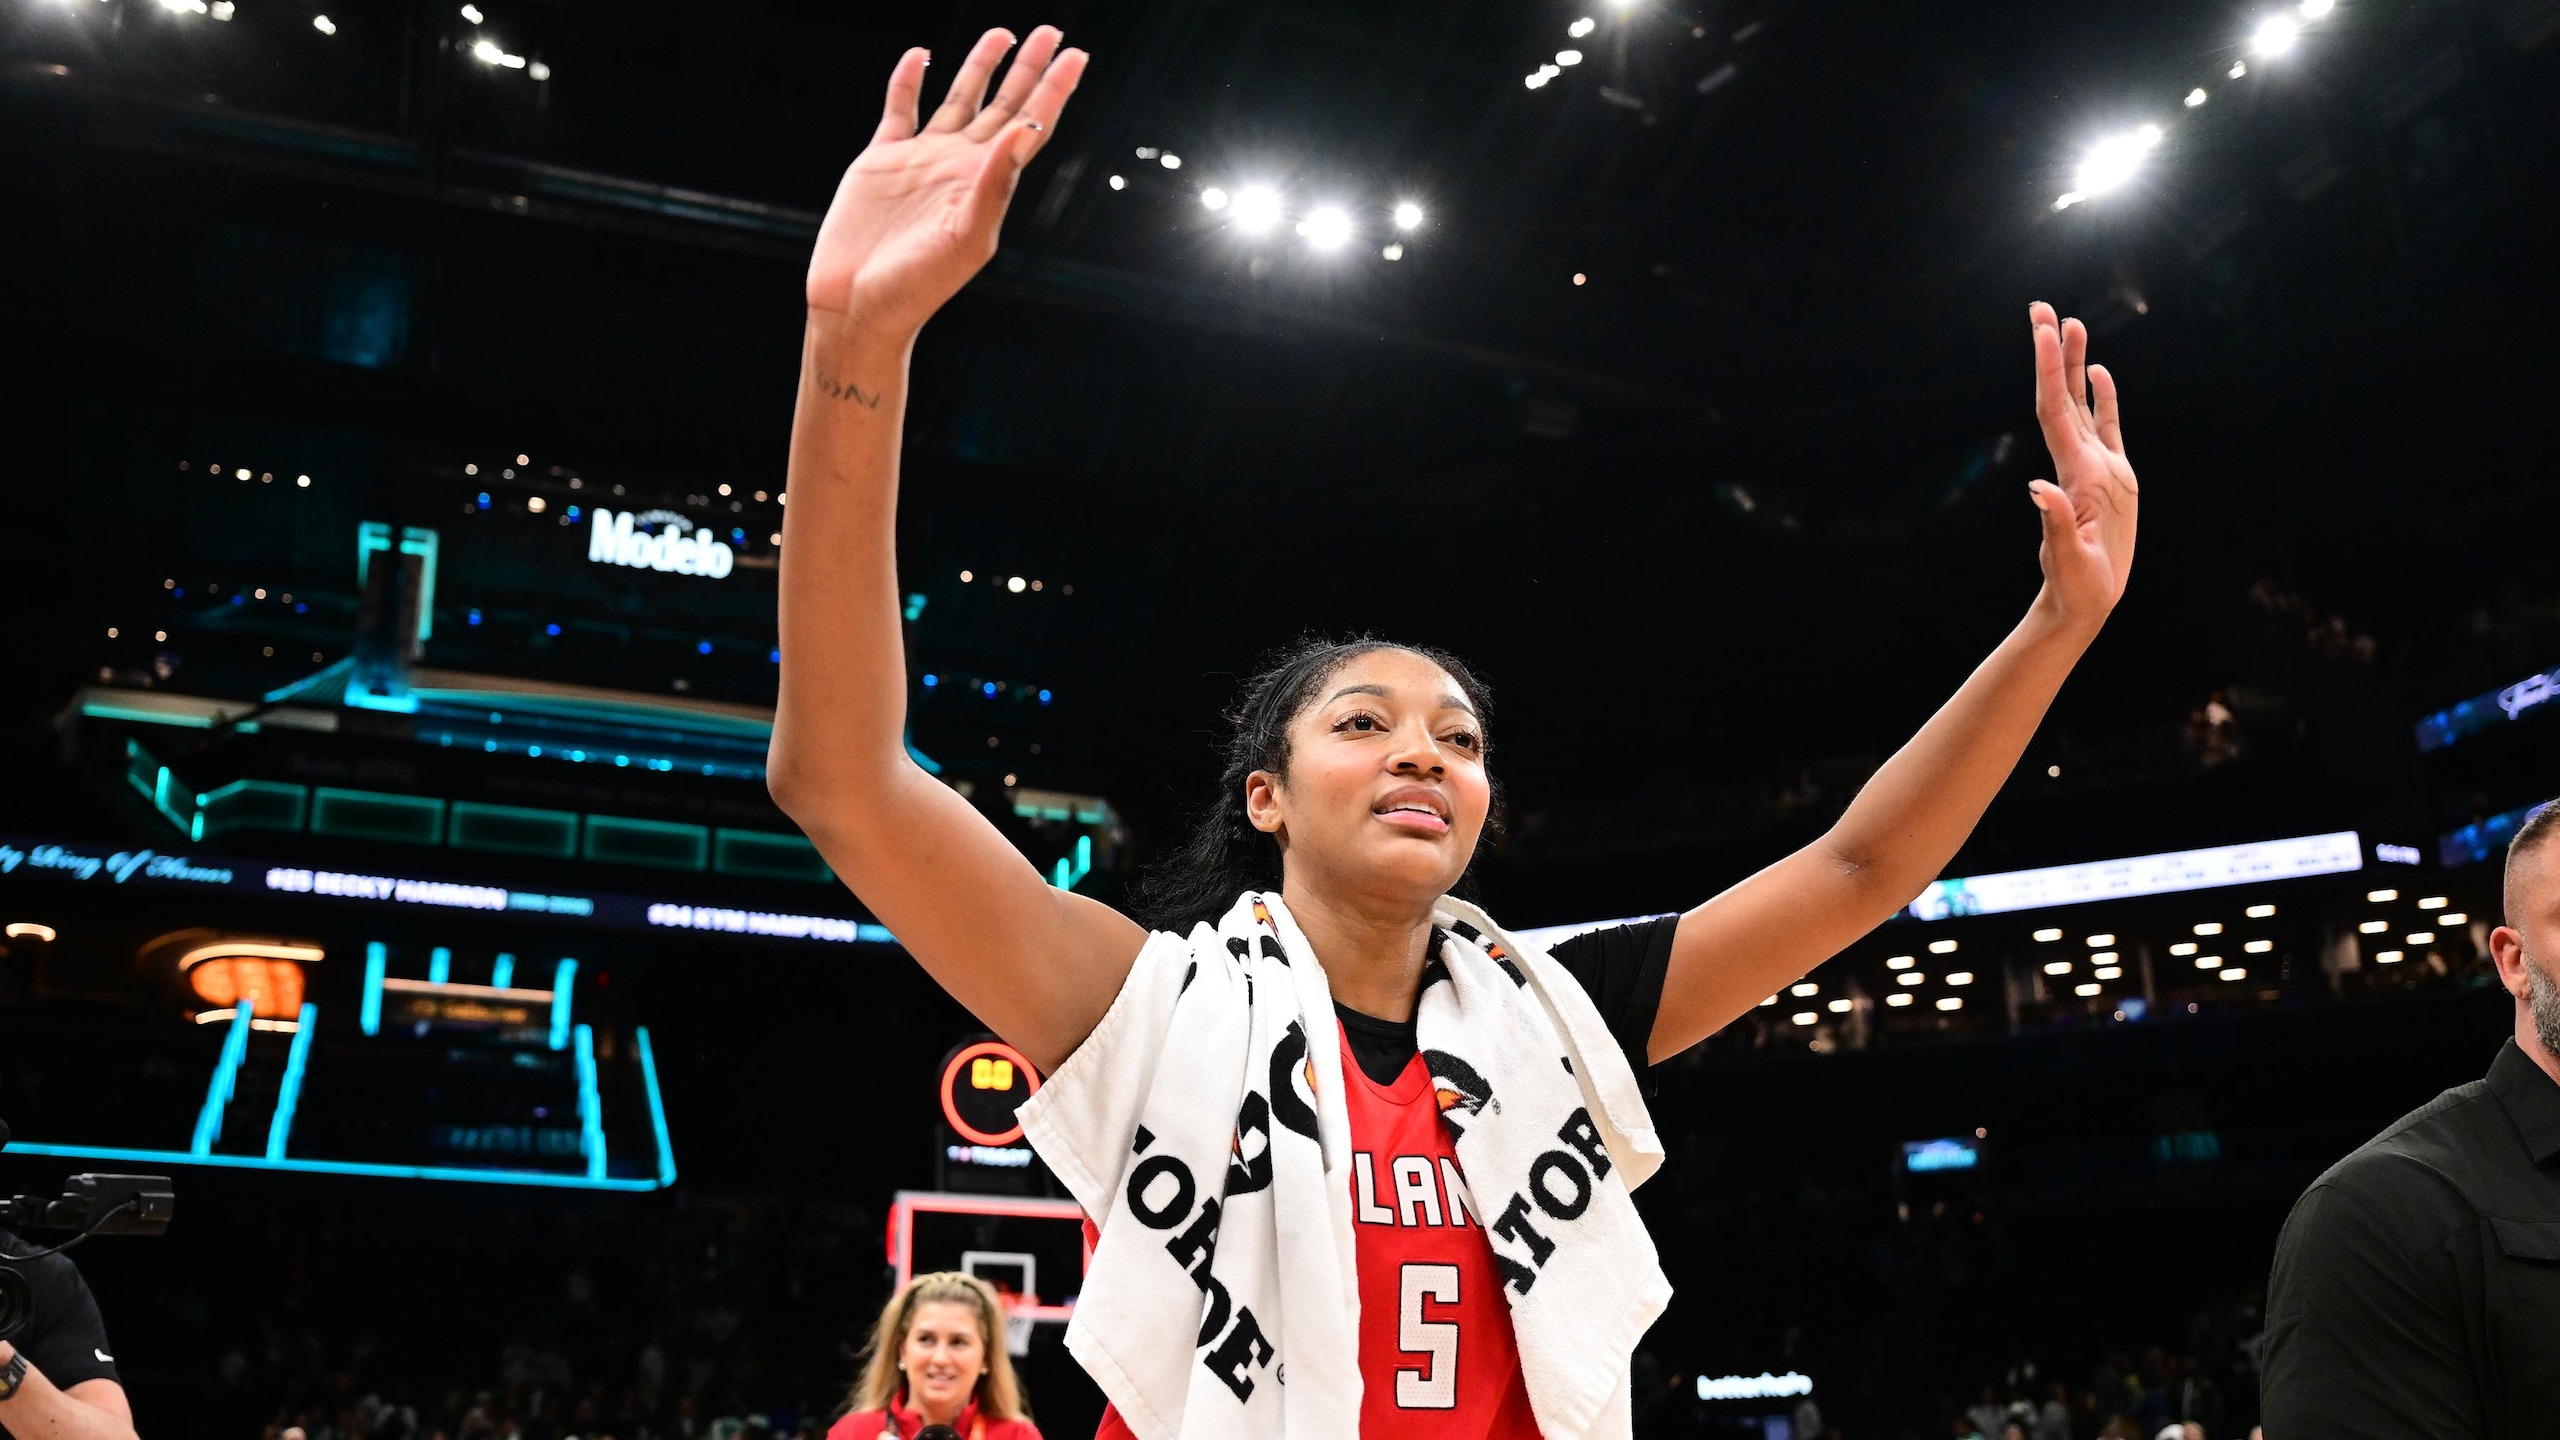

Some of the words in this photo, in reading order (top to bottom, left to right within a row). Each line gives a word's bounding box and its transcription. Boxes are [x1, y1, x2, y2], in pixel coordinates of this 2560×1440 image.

[589, 508, 734, 579] Modelo
[747, 911, 858, 942] HAMPTON
[1395, 1262, 1461, 1409] 5
